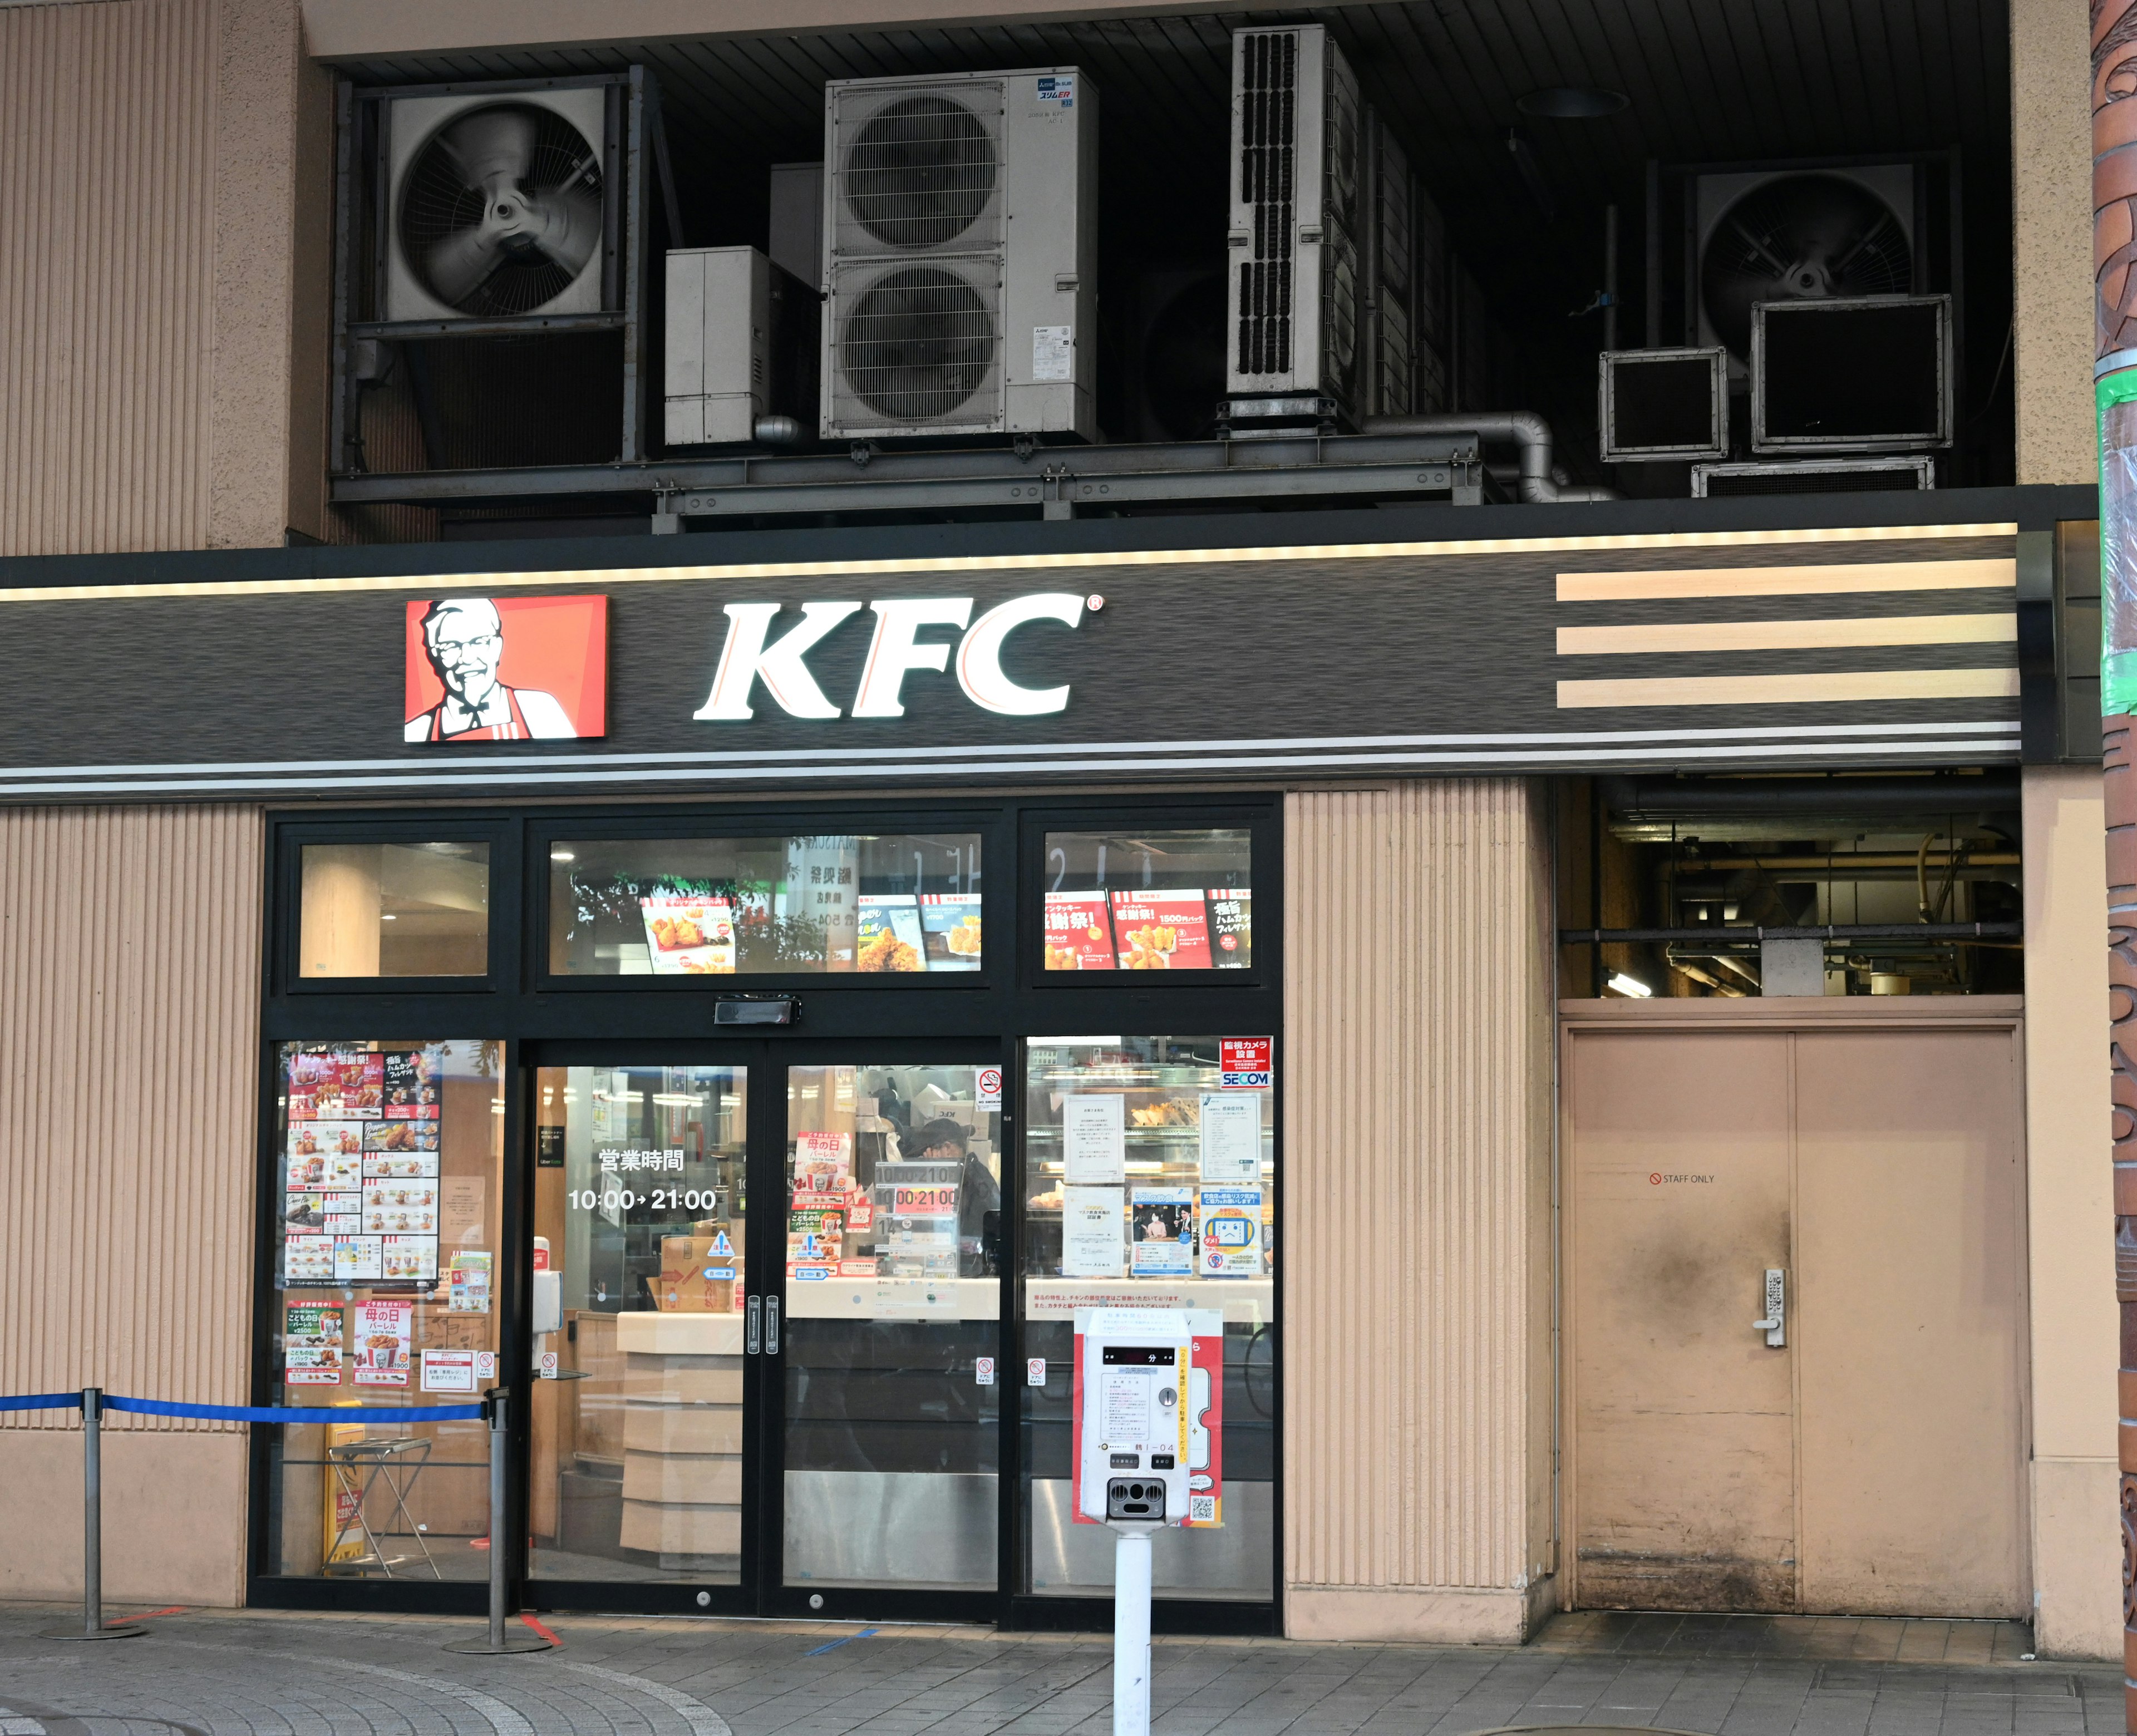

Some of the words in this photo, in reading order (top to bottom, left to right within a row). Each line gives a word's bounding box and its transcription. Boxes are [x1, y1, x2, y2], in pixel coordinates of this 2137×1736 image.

[693, 593, 1085, 720] KFC
[1214, 900, 1240, 916] 極旨
[1116, 909, 1155, 920] 感謝祭!
[1224, 1041, 1268, 1050] 監視カメラ
[1236, 1049, 1255, 1058] 設置
[338, 1055, 369, 1065] 感謝祭!
[386, 1056, 401, 1065] 極旨
[387, 1063, 411, 1072] ハムカツ
[390, 1069, 413, 1078] フィレサンド
[1223, 1073, 1268, 1085] SECOM
[365, 1122, 387, 1135] Pepper
[807, 1138, 839, 1151] 母の日
[599, 1148, 684, 1171] 営業時間
[1663, 1175, 1688, 1183] STAFF
[1691, 1175, 1714, 1183] ONLY
[568, 1190, 635, 1210] 10:00
[651, 1190, 716, 1210] 21:00
[1135, 1194, 1174, 1202] マスク飲食
[365, 1308, 399, 1322] 母の日
[1148, 1354, 1156, 1362] 分
